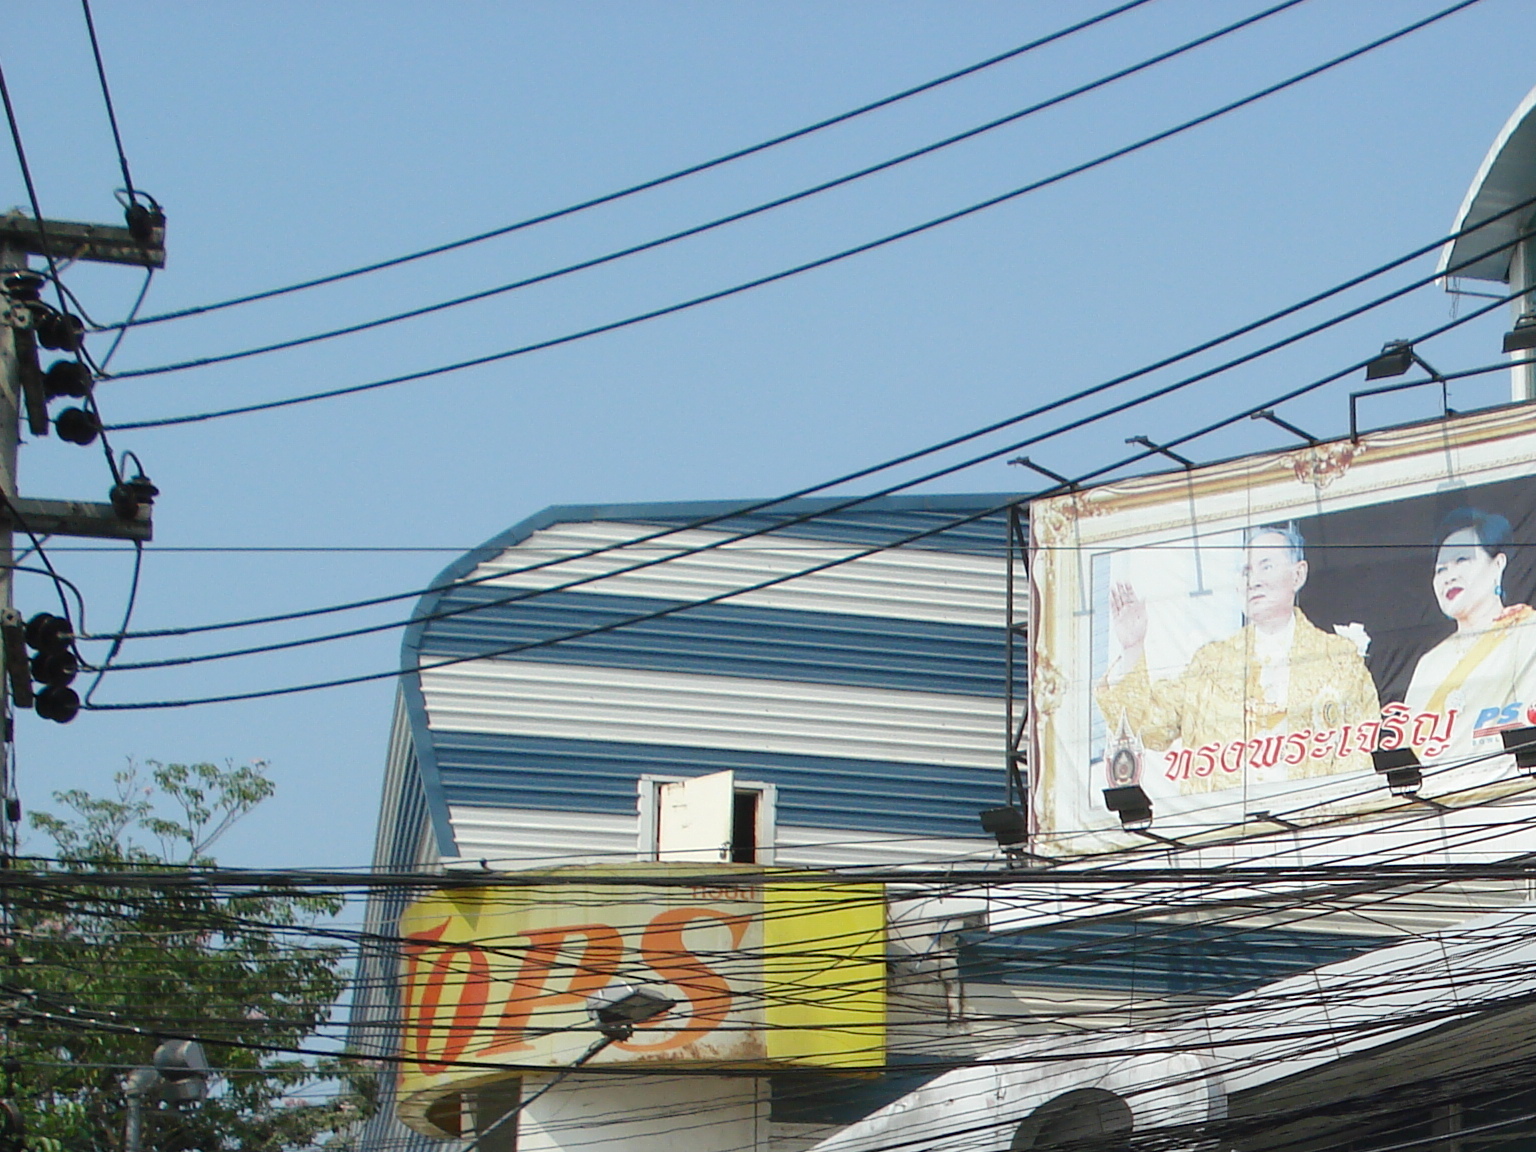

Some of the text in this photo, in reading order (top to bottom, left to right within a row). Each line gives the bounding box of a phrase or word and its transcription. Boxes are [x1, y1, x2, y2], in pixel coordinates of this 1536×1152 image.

[1164, 701, 1458, 782] ทรงพระเจริญ
